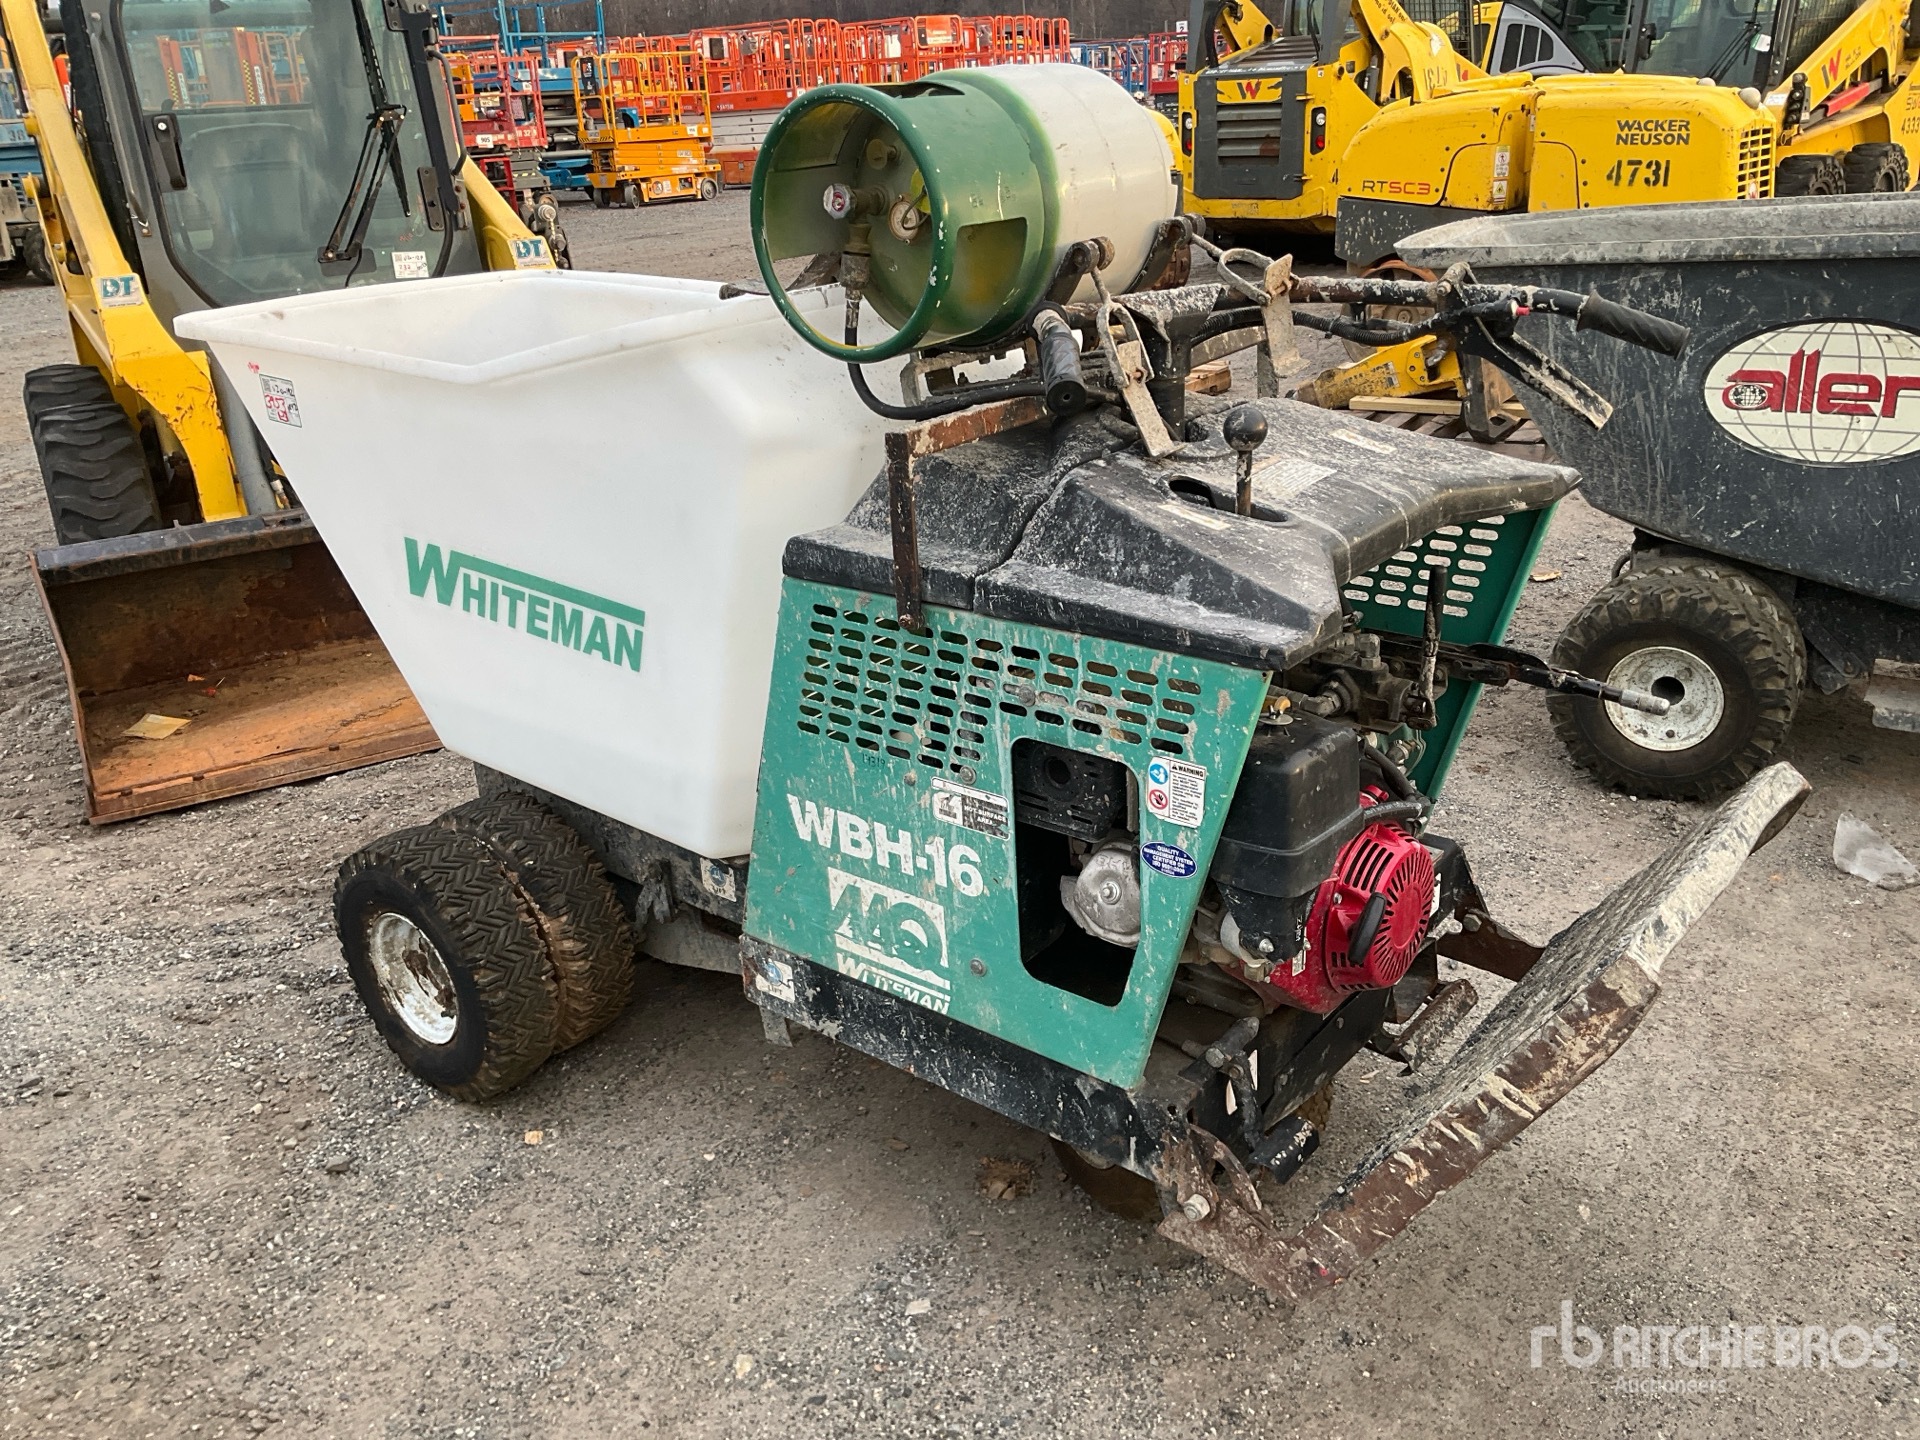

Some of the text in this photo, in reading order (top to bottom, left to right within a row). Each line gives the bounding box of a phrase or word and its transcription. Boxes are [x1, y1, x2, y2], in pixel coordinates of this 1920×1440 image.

[1617, 119, 1691, 132] WACKER
[1616, 133, 1690, 145] NEUSON
[1606, 159, 1671, 187] 4731
[1362, 180, 1431, 195] RTSC3
[516, 239, 542, 258] DT
[103, 276, 134, 298] DT
[404, 536, 646, 673] WHITEMAN
[1178, 765, 1204, 777] WARNING
[787, 793, 984, 897] WBH-16
